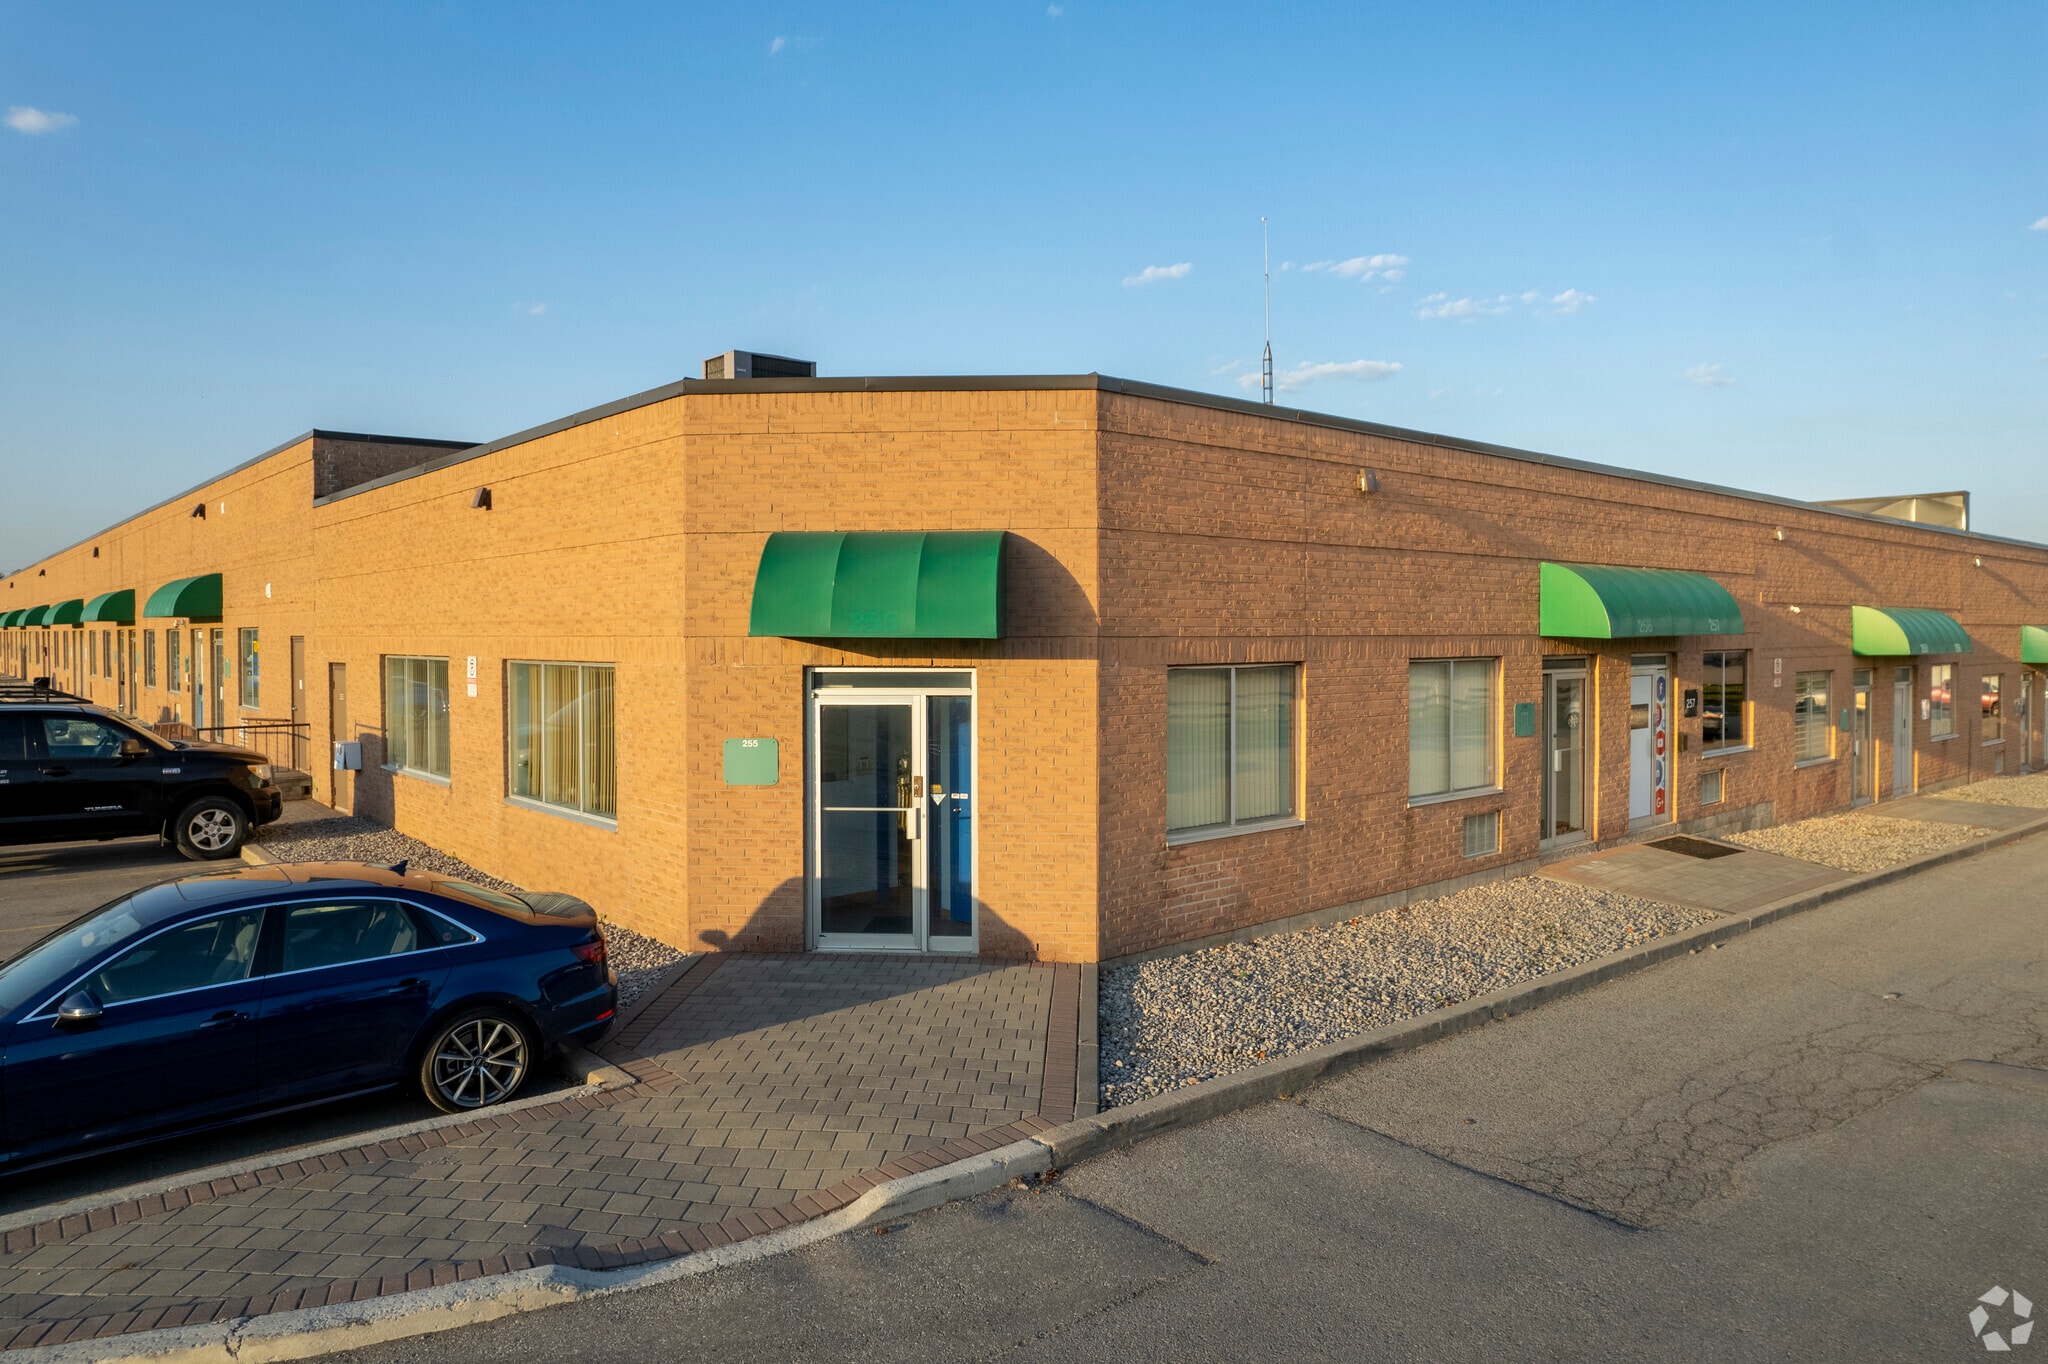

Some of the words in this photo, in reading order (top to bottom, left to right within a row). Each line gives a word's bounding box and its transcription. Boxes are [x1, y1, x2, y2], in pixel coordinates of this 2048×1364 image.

[848, 611, 898, 632] 255
[1686, 698, 1696, 709] 257
[742, 739, 759, 748] 255
